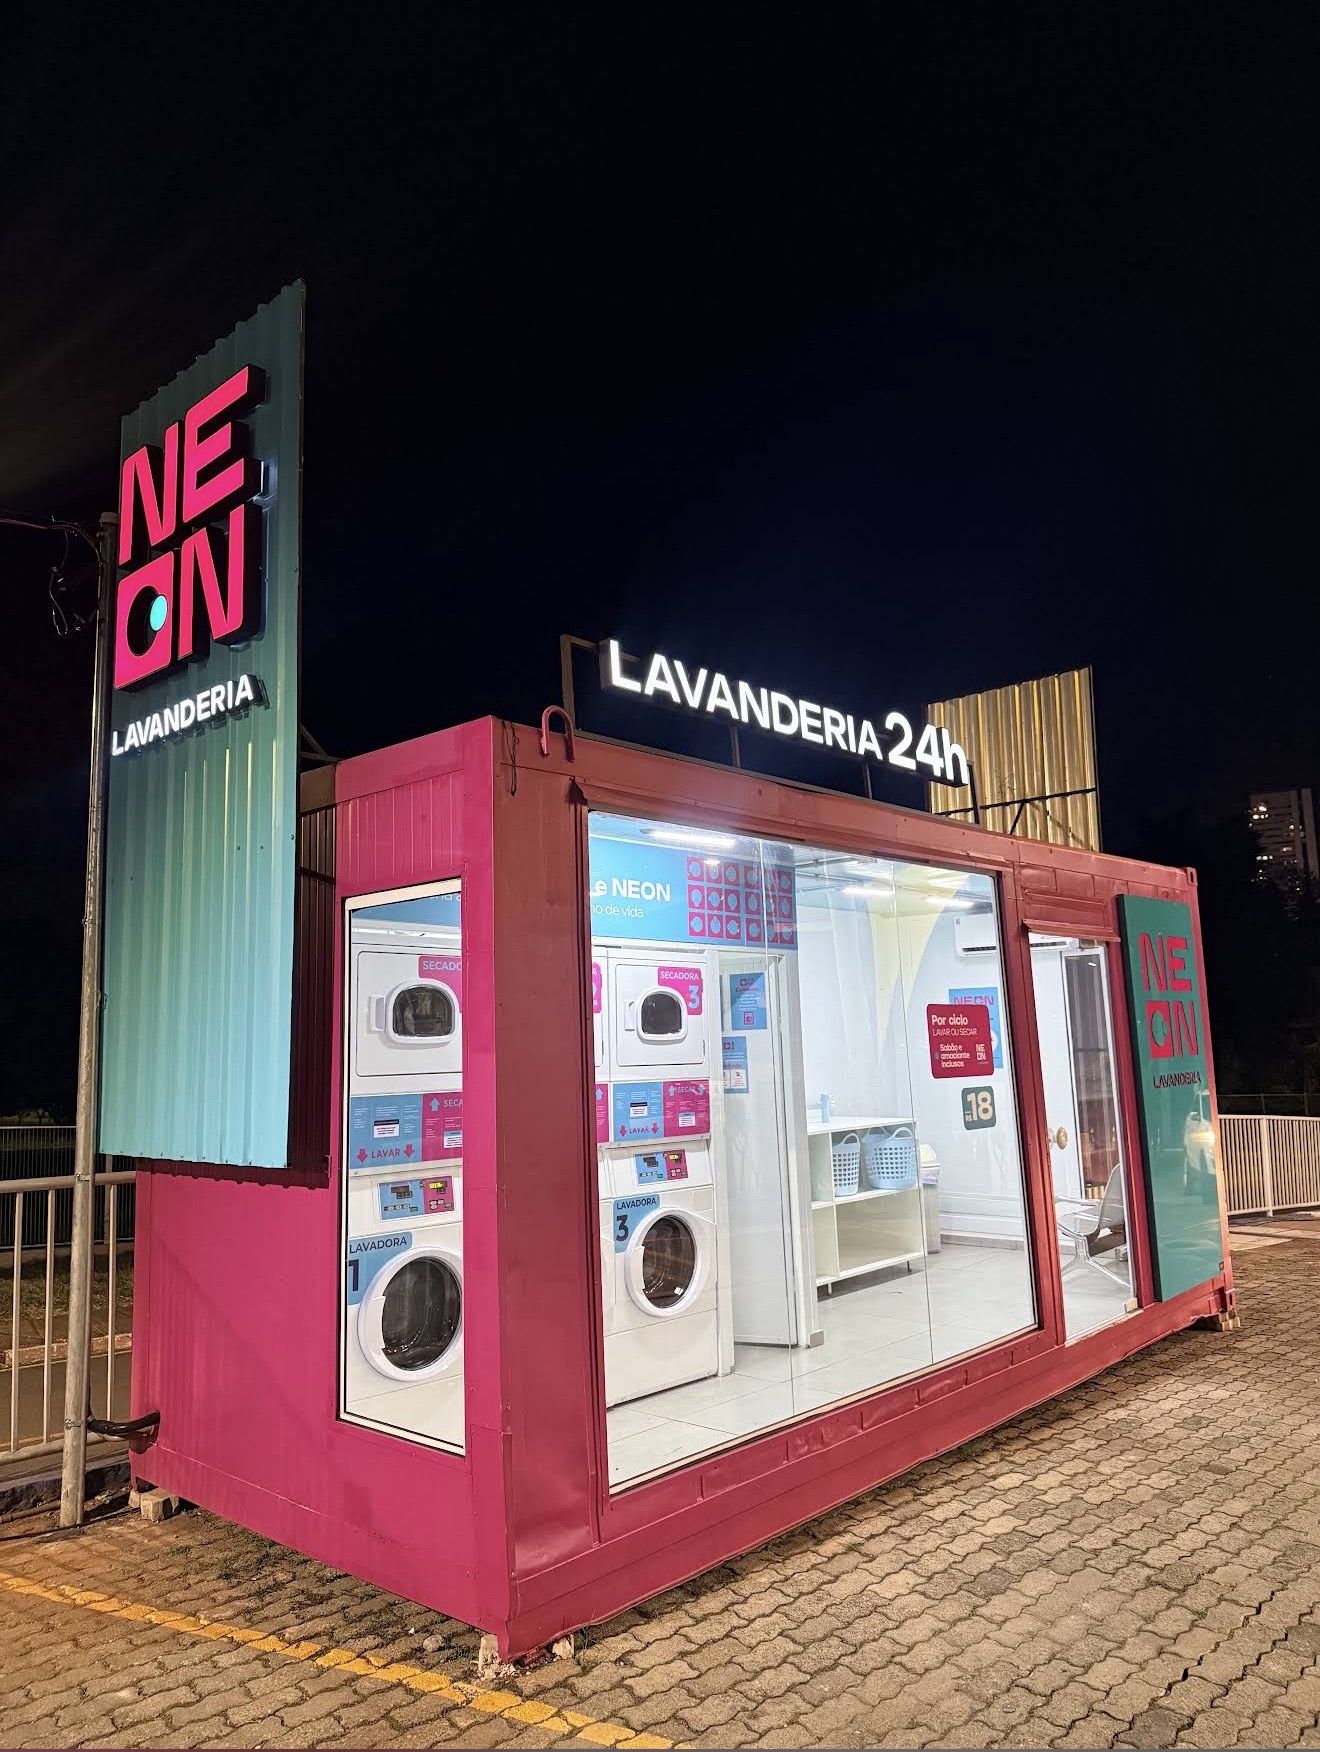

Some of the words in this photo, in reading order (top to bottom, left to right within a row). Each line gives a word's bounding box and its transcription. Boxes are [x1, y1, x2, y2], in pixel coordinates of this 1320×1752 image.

[111, 684, 254, 757] LAVANDERIA
[608, 639, 883, 761] LAVANDERIA
[884, 711, 970, 785] 24h
[611, 877, 671, 902] NEON
[605, 903, 620, 916] de
[621, 904, 644, 918] vida
[660, 970, 699, 981] SECADORA
[688, 984, 699, 1009] 3
[931, 1014, 947, 1026] Por
[948, 1012, 968, 1026] ciclo
[932, 1028, 951, 1037] LAVAR
[960, 1028, 977, 1036] SECAR
[1153, 1071, 1202, 1089] LAVANDERIA
[966, 1091, 993, 1121] 18
[371, 1148, 401, 1159] LAVAR
[616, 1197, 657, 1211] LAVADORA
[615, 1214, 629, 1242] 3
[349, 1236, 407, 1254] LAVADORA
[348, 1259, 360, 1292] 1
